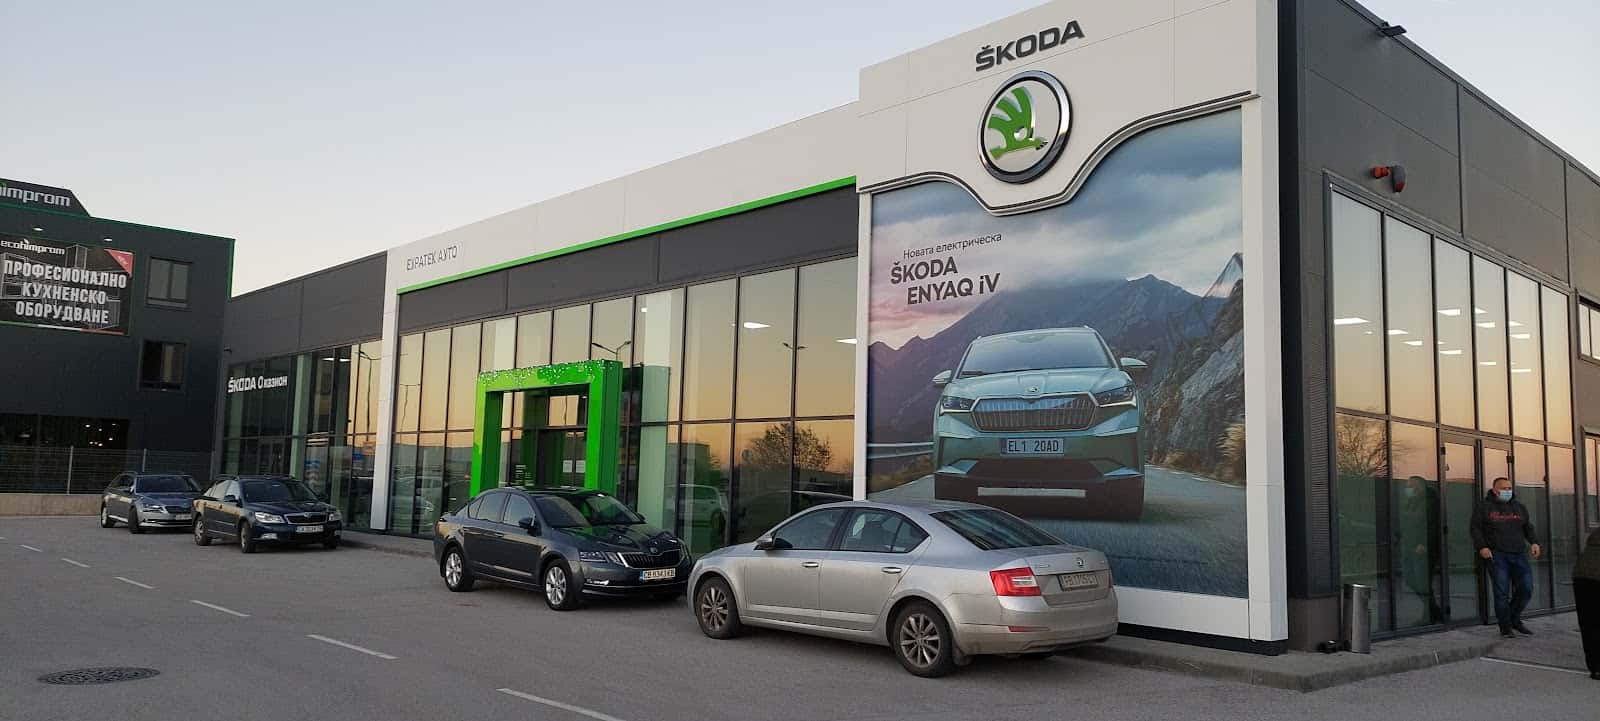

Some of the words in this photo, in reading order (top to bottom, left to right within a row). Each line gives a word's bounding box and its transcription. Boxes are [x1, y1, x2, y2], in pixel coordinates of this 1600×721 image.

[976, 20, 1085, 72] ŠKODA
[0, 239, 65, 255] ecohimprom
[903, 246, 934, 259] Новата
[936, 233, 1002, 253] електрическа
[3, 259, 127, 289] ПРОФЕСИОНАЛНО
[890, 256, 958, 285] ŠKODA
[22, 283, 106, 305] КУХНЕНСКО
[907, 278, 974, 305] ENYAQ
[979, 272, 1001, 295] iV
[15, 301, 110, 324] ОБОРУДВАНЕ
[228, 375, 257, 393] ŠKODA
